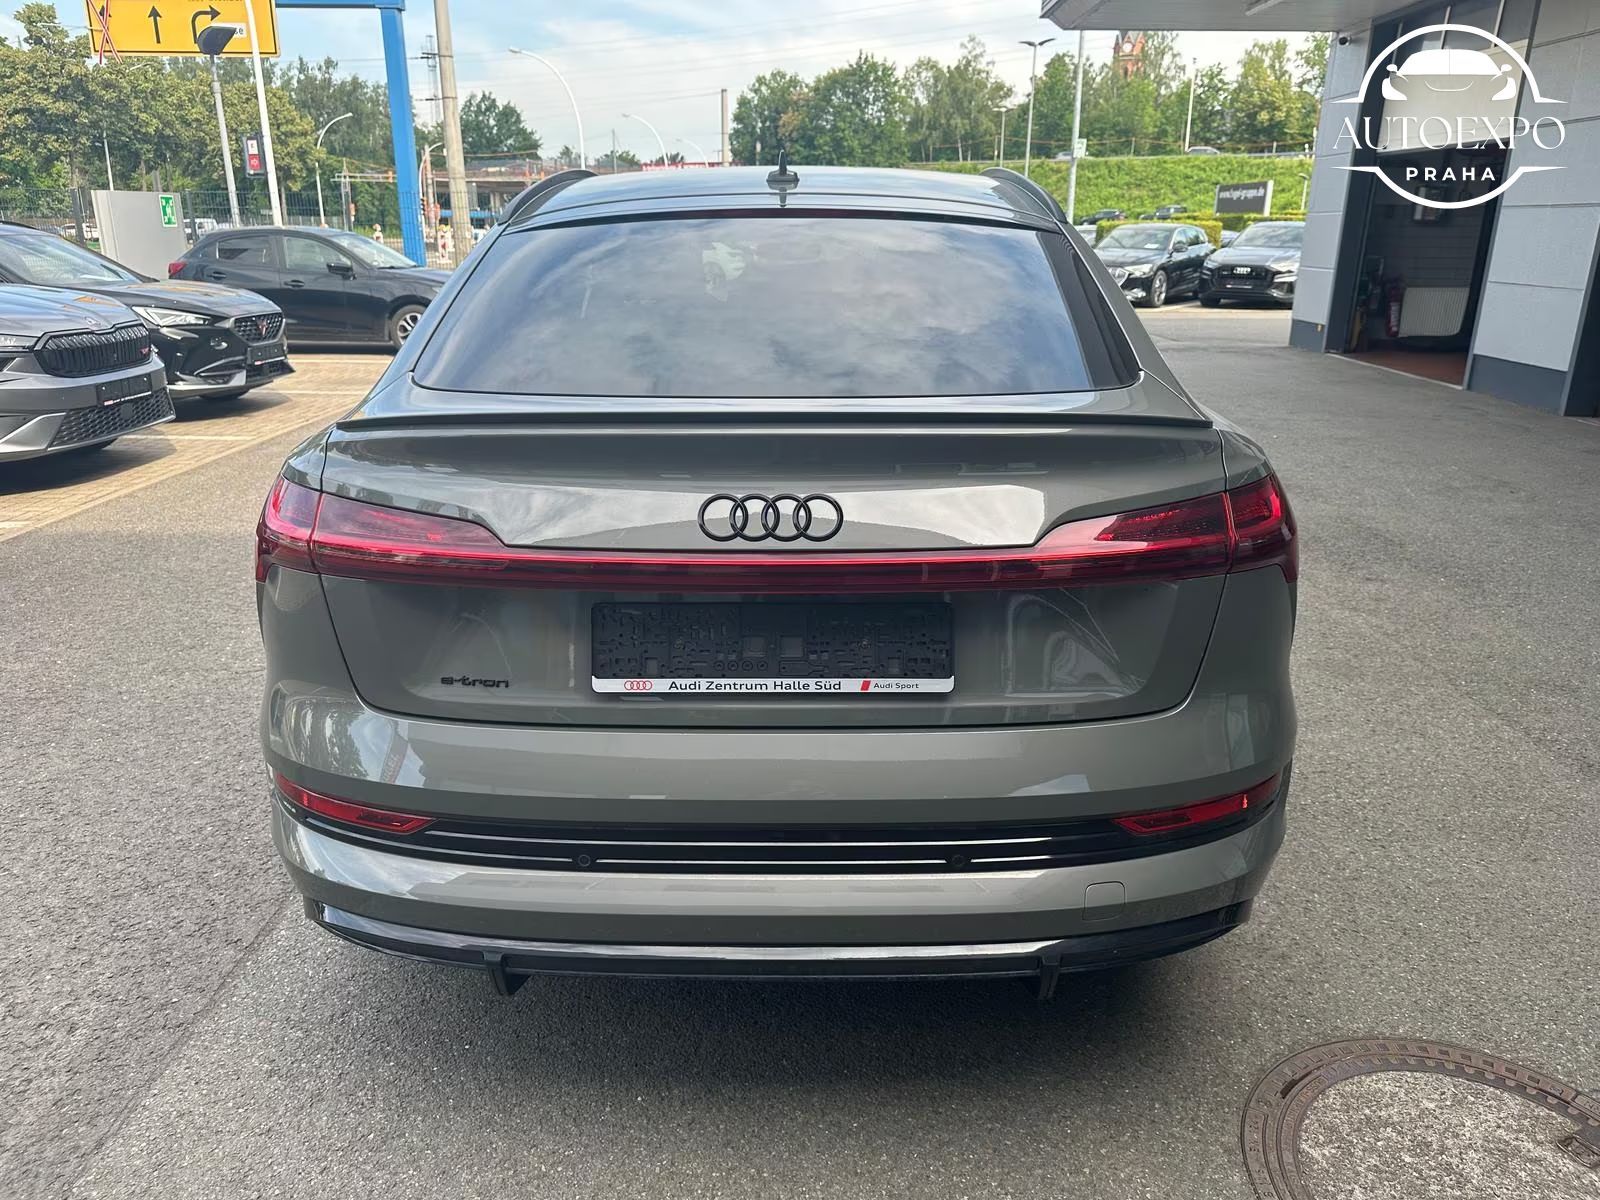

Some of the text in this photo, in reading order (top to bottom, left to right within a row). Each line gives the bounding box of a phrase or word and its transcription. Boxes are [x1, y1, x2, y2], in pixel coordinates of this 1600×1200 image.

[440, 675, 509, 688] e-tron
[668, 680, 841, 691] Audi Zentrum Halle Süd
[895, 682, 920, 690] Sport
